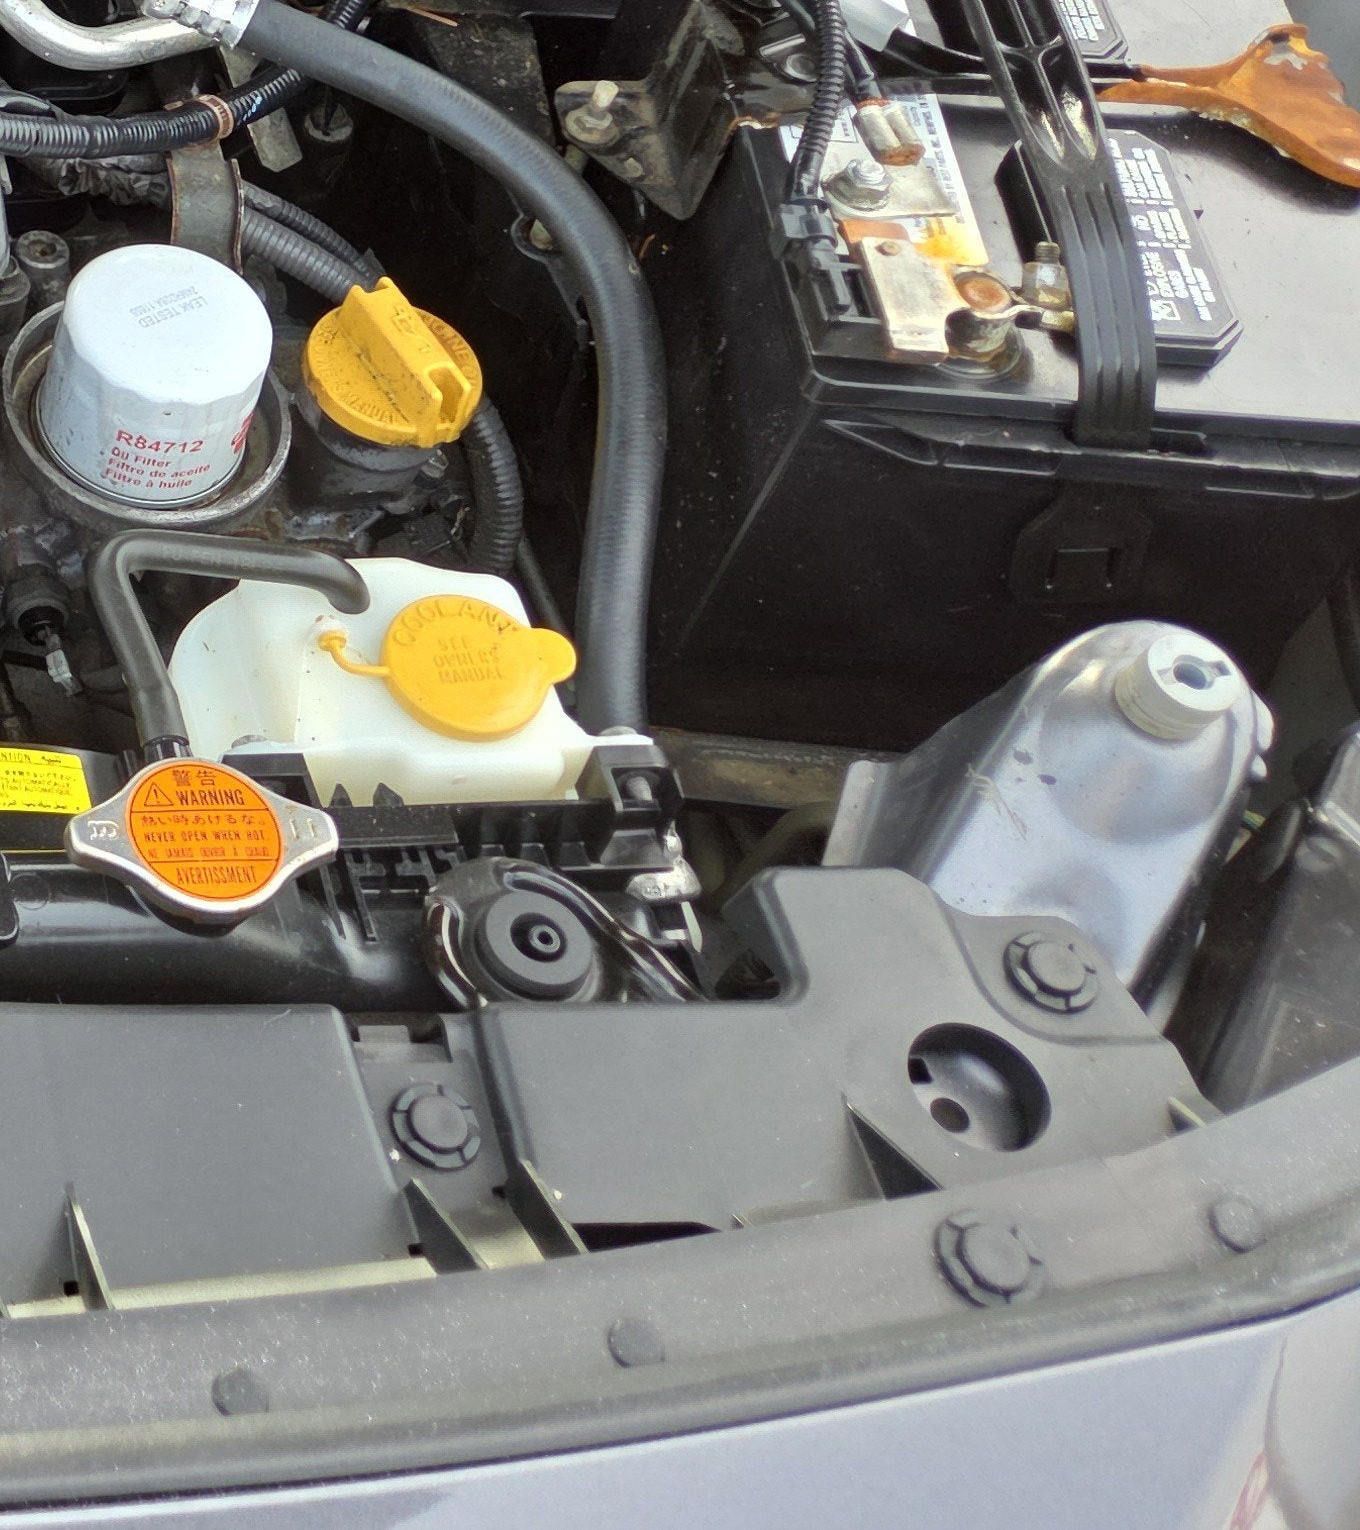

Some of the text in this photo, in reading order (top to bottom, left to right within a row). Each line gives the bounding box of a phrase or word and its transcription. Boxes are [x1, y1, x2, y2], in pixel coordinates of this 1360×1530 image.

[176, 296, 209, 314] LEAK
[138, 308, 176, 328] TESTED
[116, 429, 203, 453] R84712
[111, 446, 172, 468] Oil Filter
[108, 457, 211, 478] Filtro de aceite
[104, 468, 141, 486] Filtre
[159, 479, 192, 489] huile
[393, 599, 516, 647] COOLANT
[171, 769, 217, 787] 警告
[175, 789, 245, 806] WARNING
[143, 830, 175, 843] NEVER
[181, 830, 207, 842] OPEN
[212, 830, 241, 842] WHEN
[175, 865, 257, 885] AVERTISSMENT
